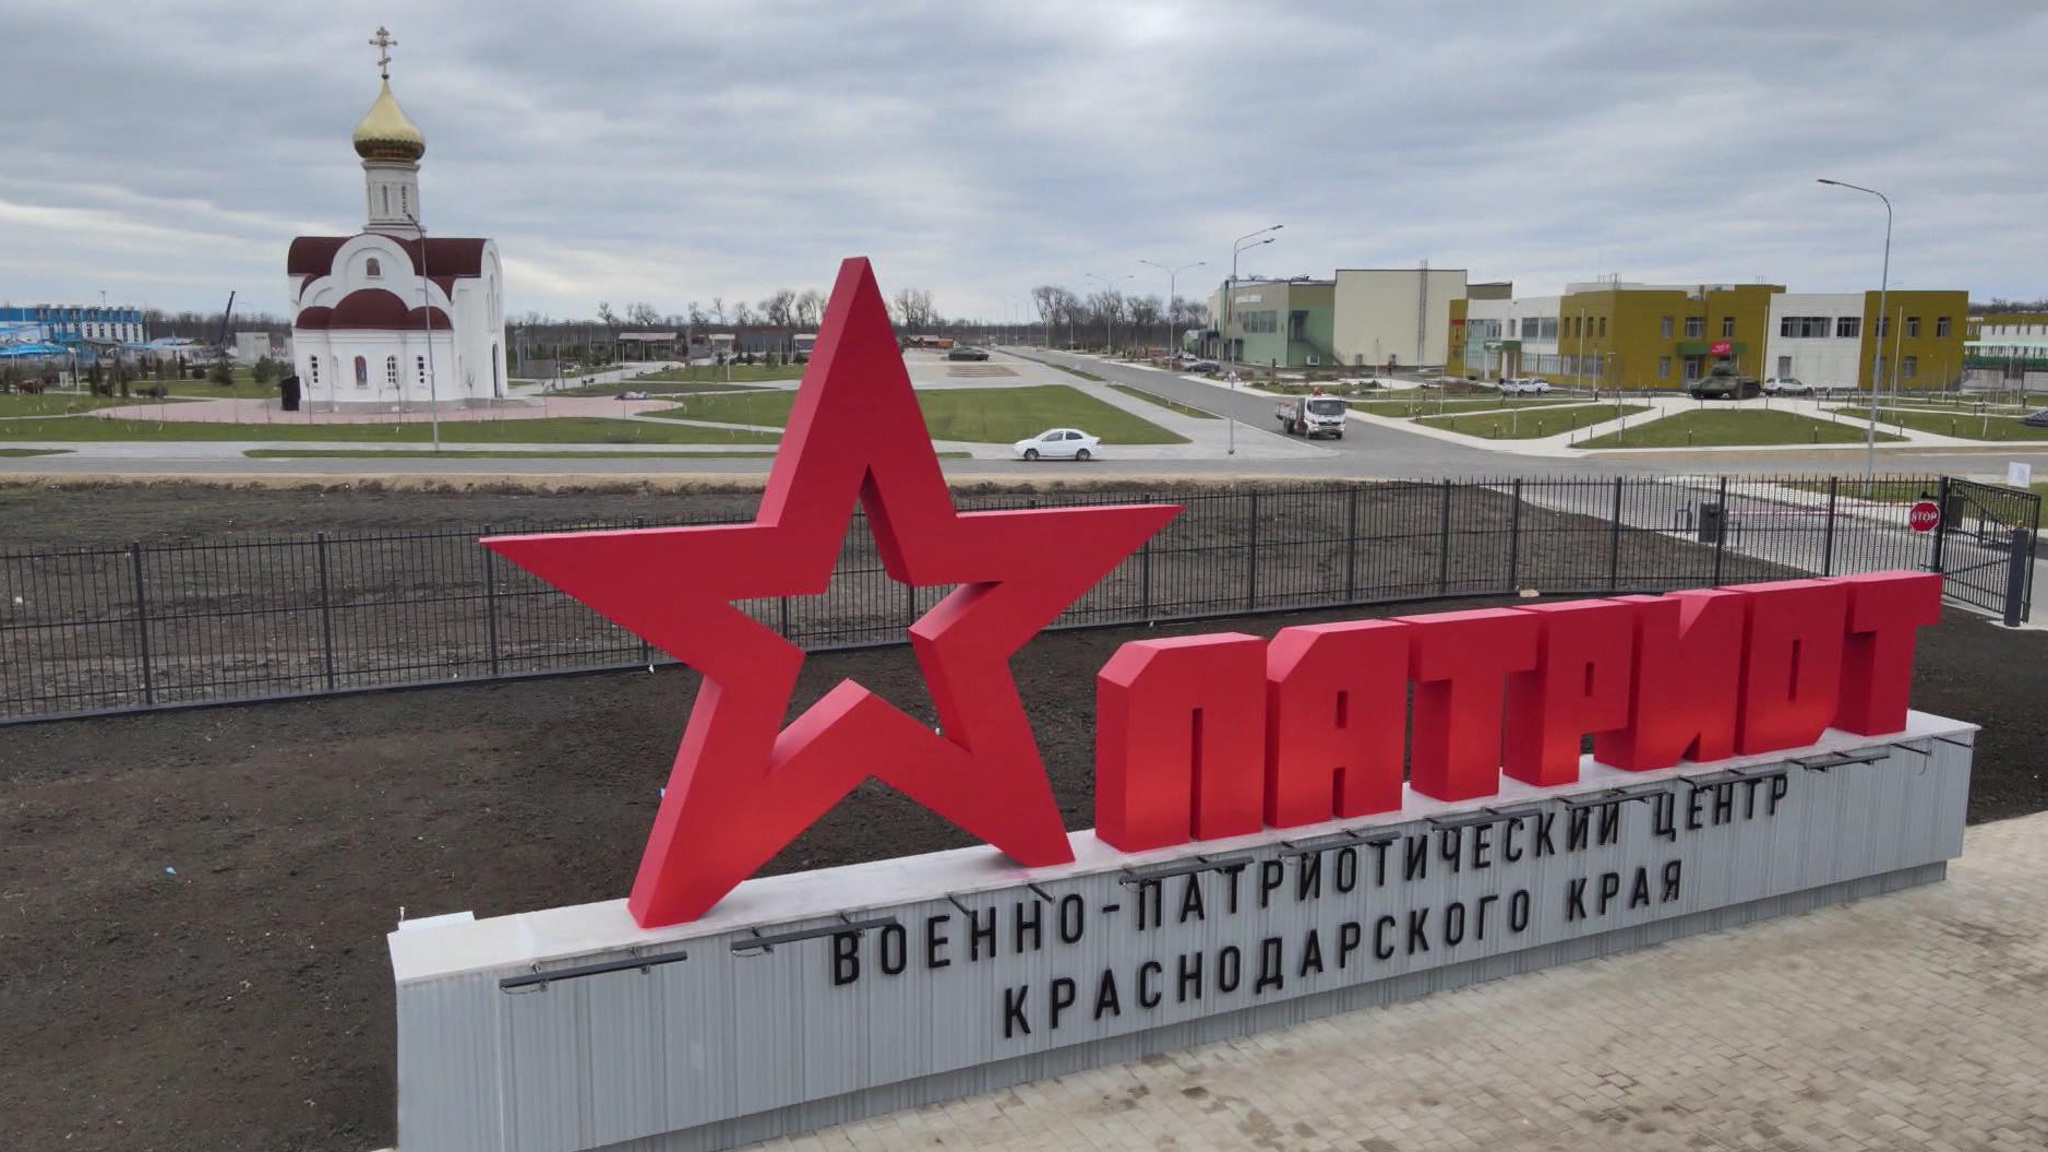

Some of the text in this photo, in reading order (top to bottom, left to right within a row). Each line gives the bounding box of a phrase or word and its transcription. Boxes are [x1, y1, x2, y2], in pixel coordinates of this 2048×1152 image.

[1912, 511, 1938, 523] STOP
[1095, 570, 1943, 853] ПАТРИОТ
[1654, 774, 1789, 842] ЦЕНТР
[1003, 859, 1682, 1039] КРАСНОДАРСКОГО КРАЯ
